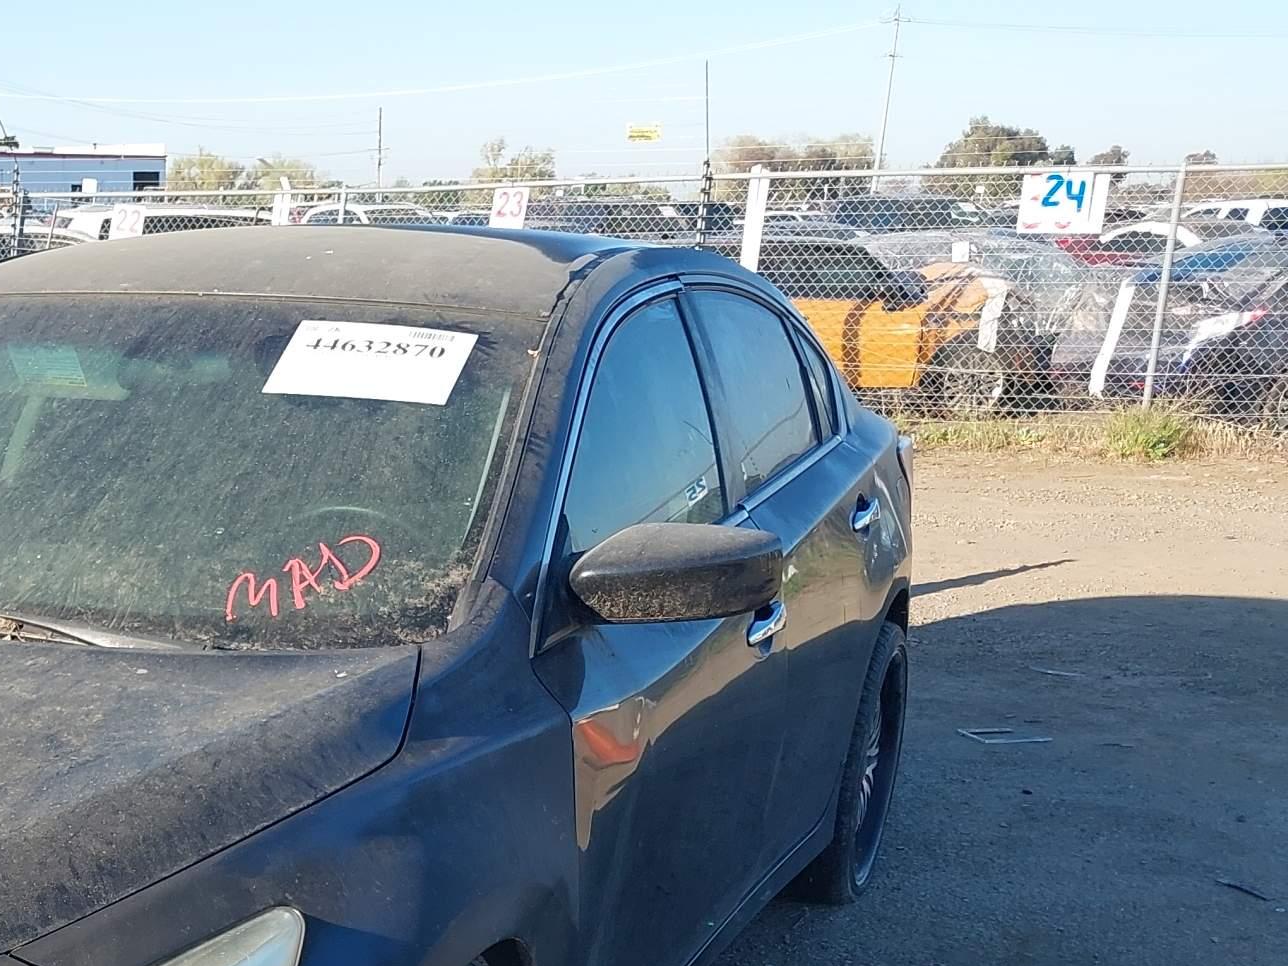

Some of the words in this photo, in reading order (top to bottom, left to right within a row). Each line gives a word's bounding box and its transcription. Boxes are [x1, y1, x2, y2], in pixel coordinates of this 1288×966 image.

[495, 191, 523, 218] 23
[1041, 173, 1086, 213] 24
[116, 208, 141, 233] 22
[306, 337, 446, 359] 44632870
[225, 534, 381, 622] MAD
